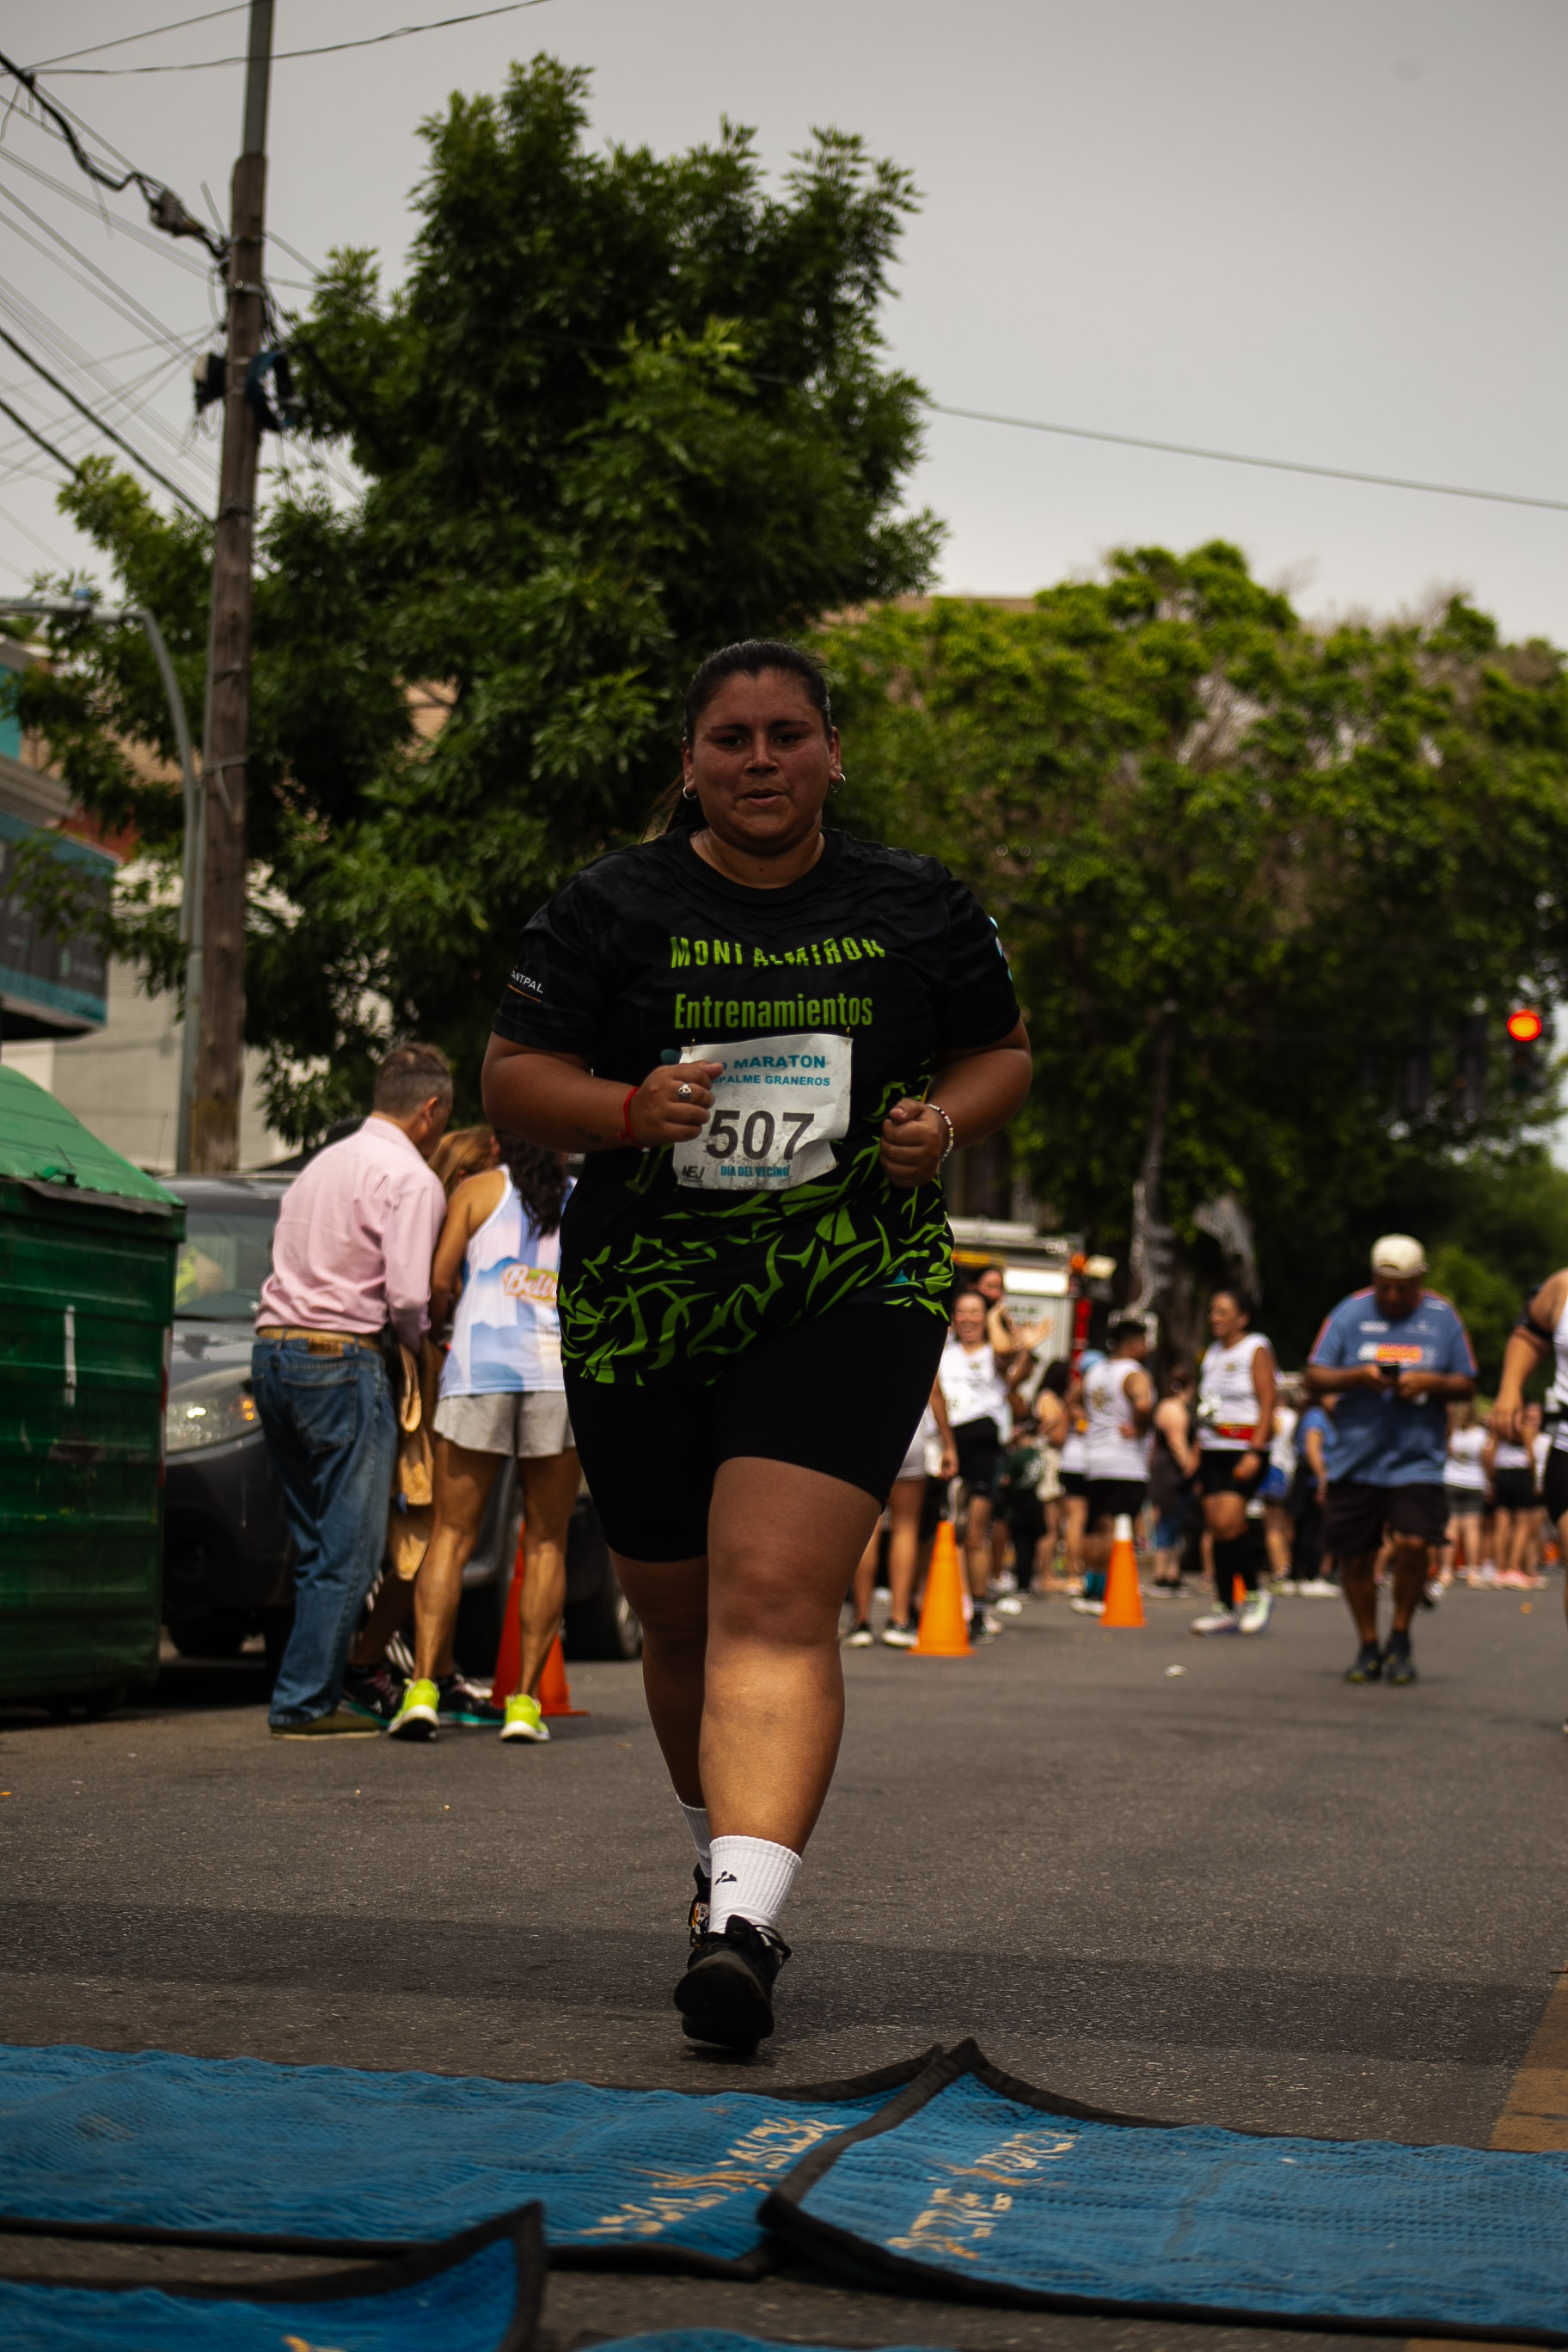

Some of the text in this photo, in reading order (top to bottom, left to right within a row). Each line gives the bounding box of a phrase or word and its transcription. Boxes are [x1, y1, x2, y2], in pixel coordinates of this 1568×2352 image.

[671, 936, 743, 968] MONI
[675, 993, 873, 1029] Entrenamientos
[734, 1055, 826, 1069] MARATON
[764, 1075, 830, 1087] GRANEROS
[706, 1109, 815, 1161] 507
[720, 1166, 789, 1178] DIA DEL VECINO
